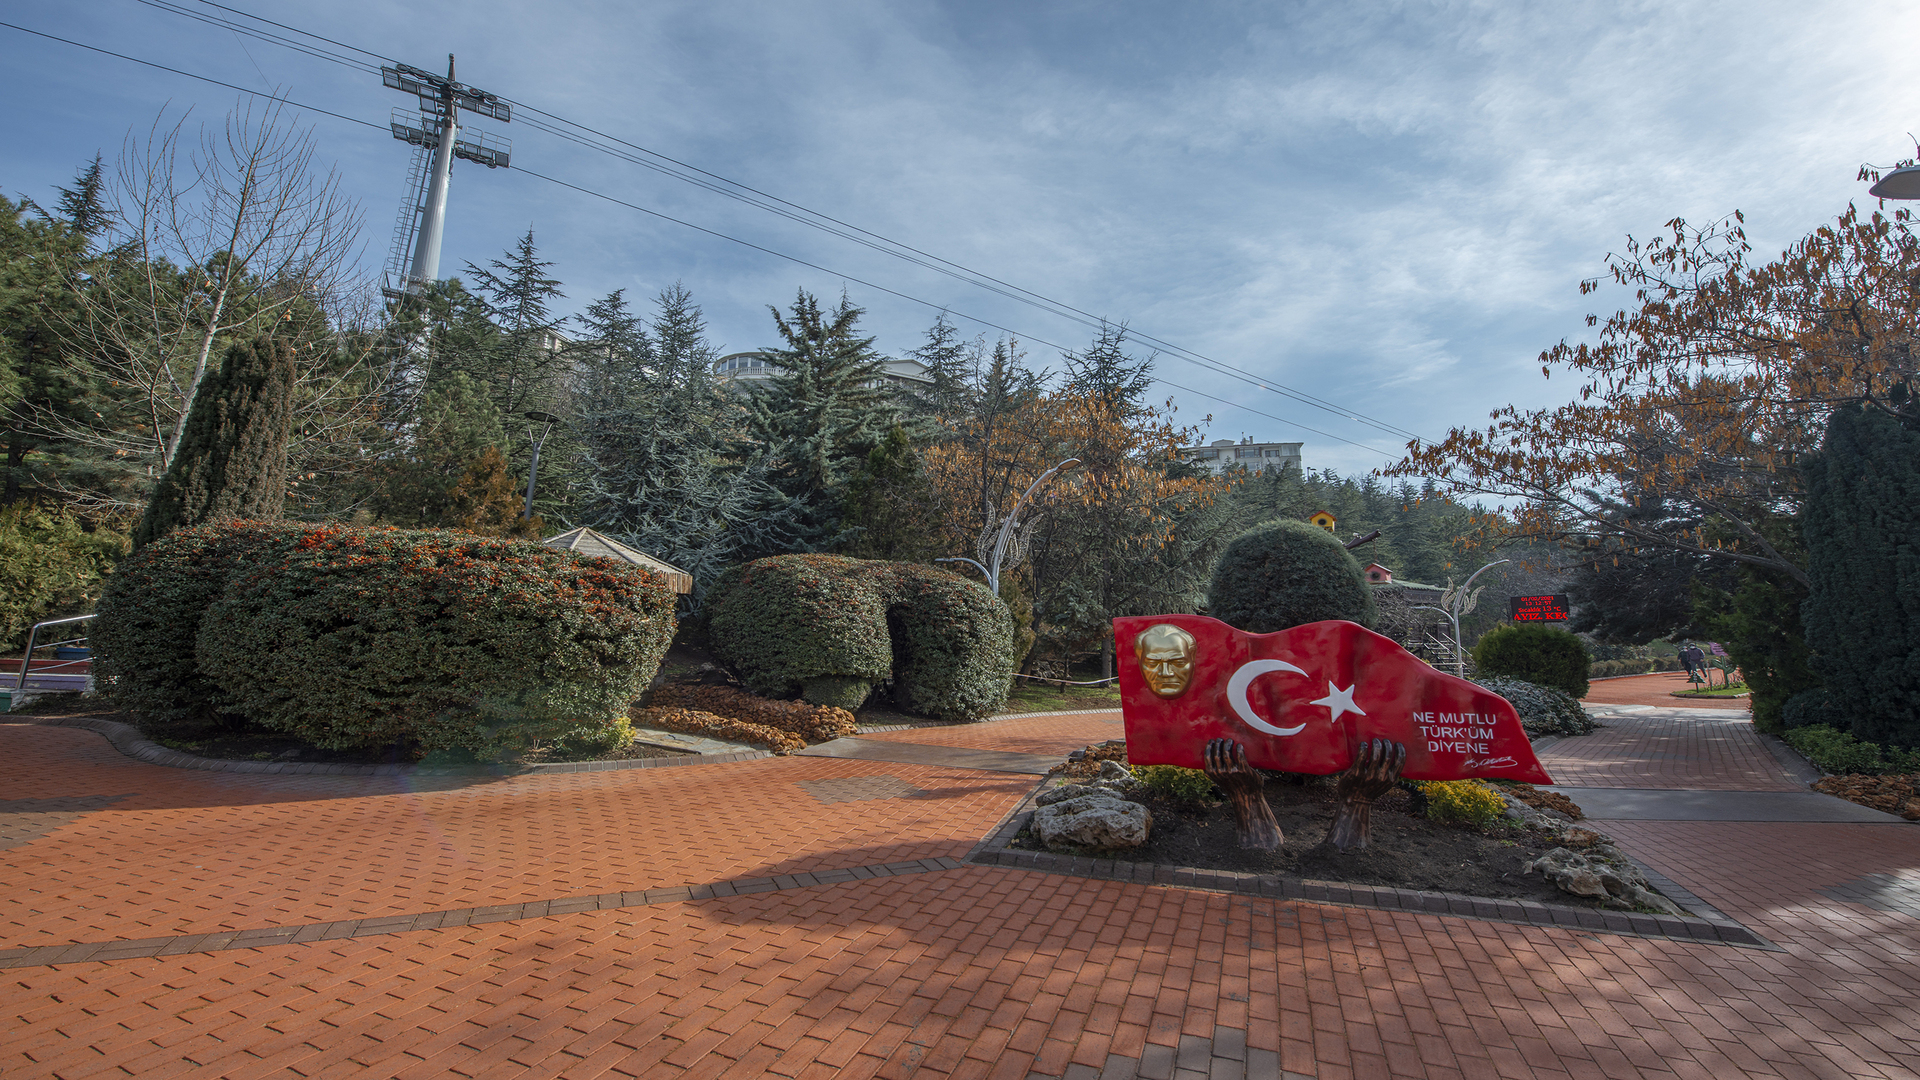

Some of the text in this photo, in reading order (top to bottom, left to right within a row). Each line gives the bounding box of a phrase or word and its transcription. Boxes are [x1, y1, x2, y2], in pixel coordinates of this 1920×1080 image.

[1413, 711, 1497, 725] NE MUTLU
[1419, 725, 1494, 740] TÜRK'ÜM
[1428, 740, 1490, 754] DİYENE
